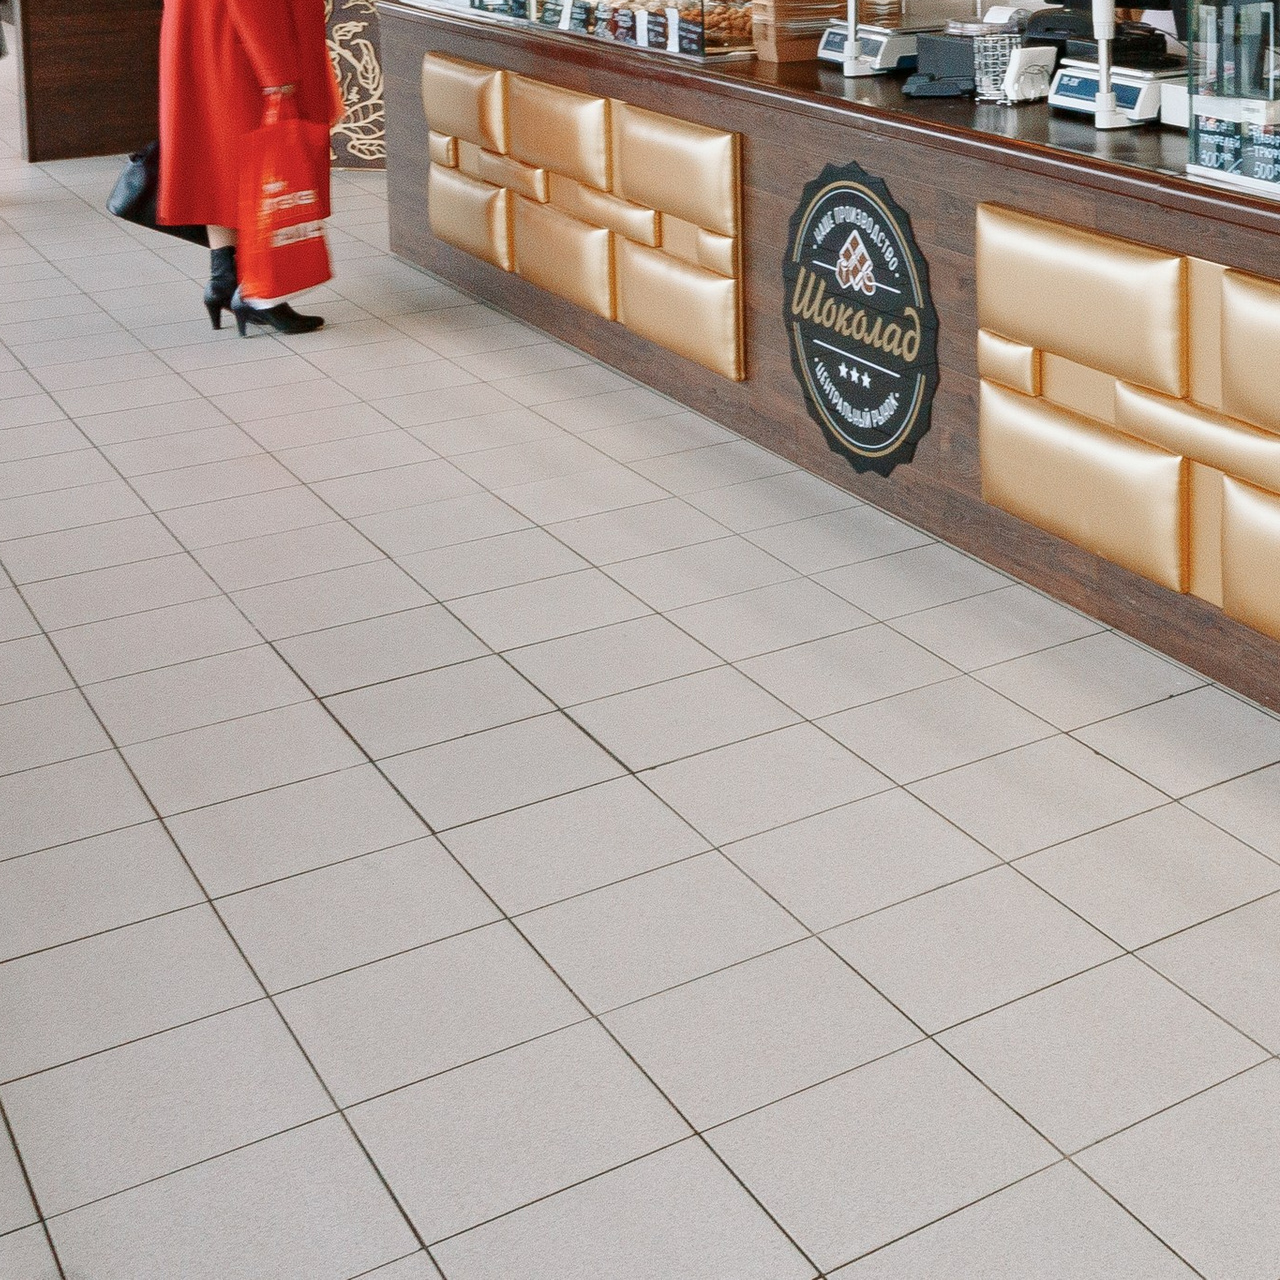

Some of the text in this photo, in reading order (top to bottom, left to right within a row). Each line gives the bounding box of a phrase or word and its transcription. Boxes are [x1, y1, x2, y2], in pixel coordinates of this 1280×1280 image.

[833, 205, 899, 271] ПРОИЗВОДСТВО
[791, 266, 921, 363] Шоколад
[815, 361, 872, 429] ЦЕНТРАЛЬНЫЙ
